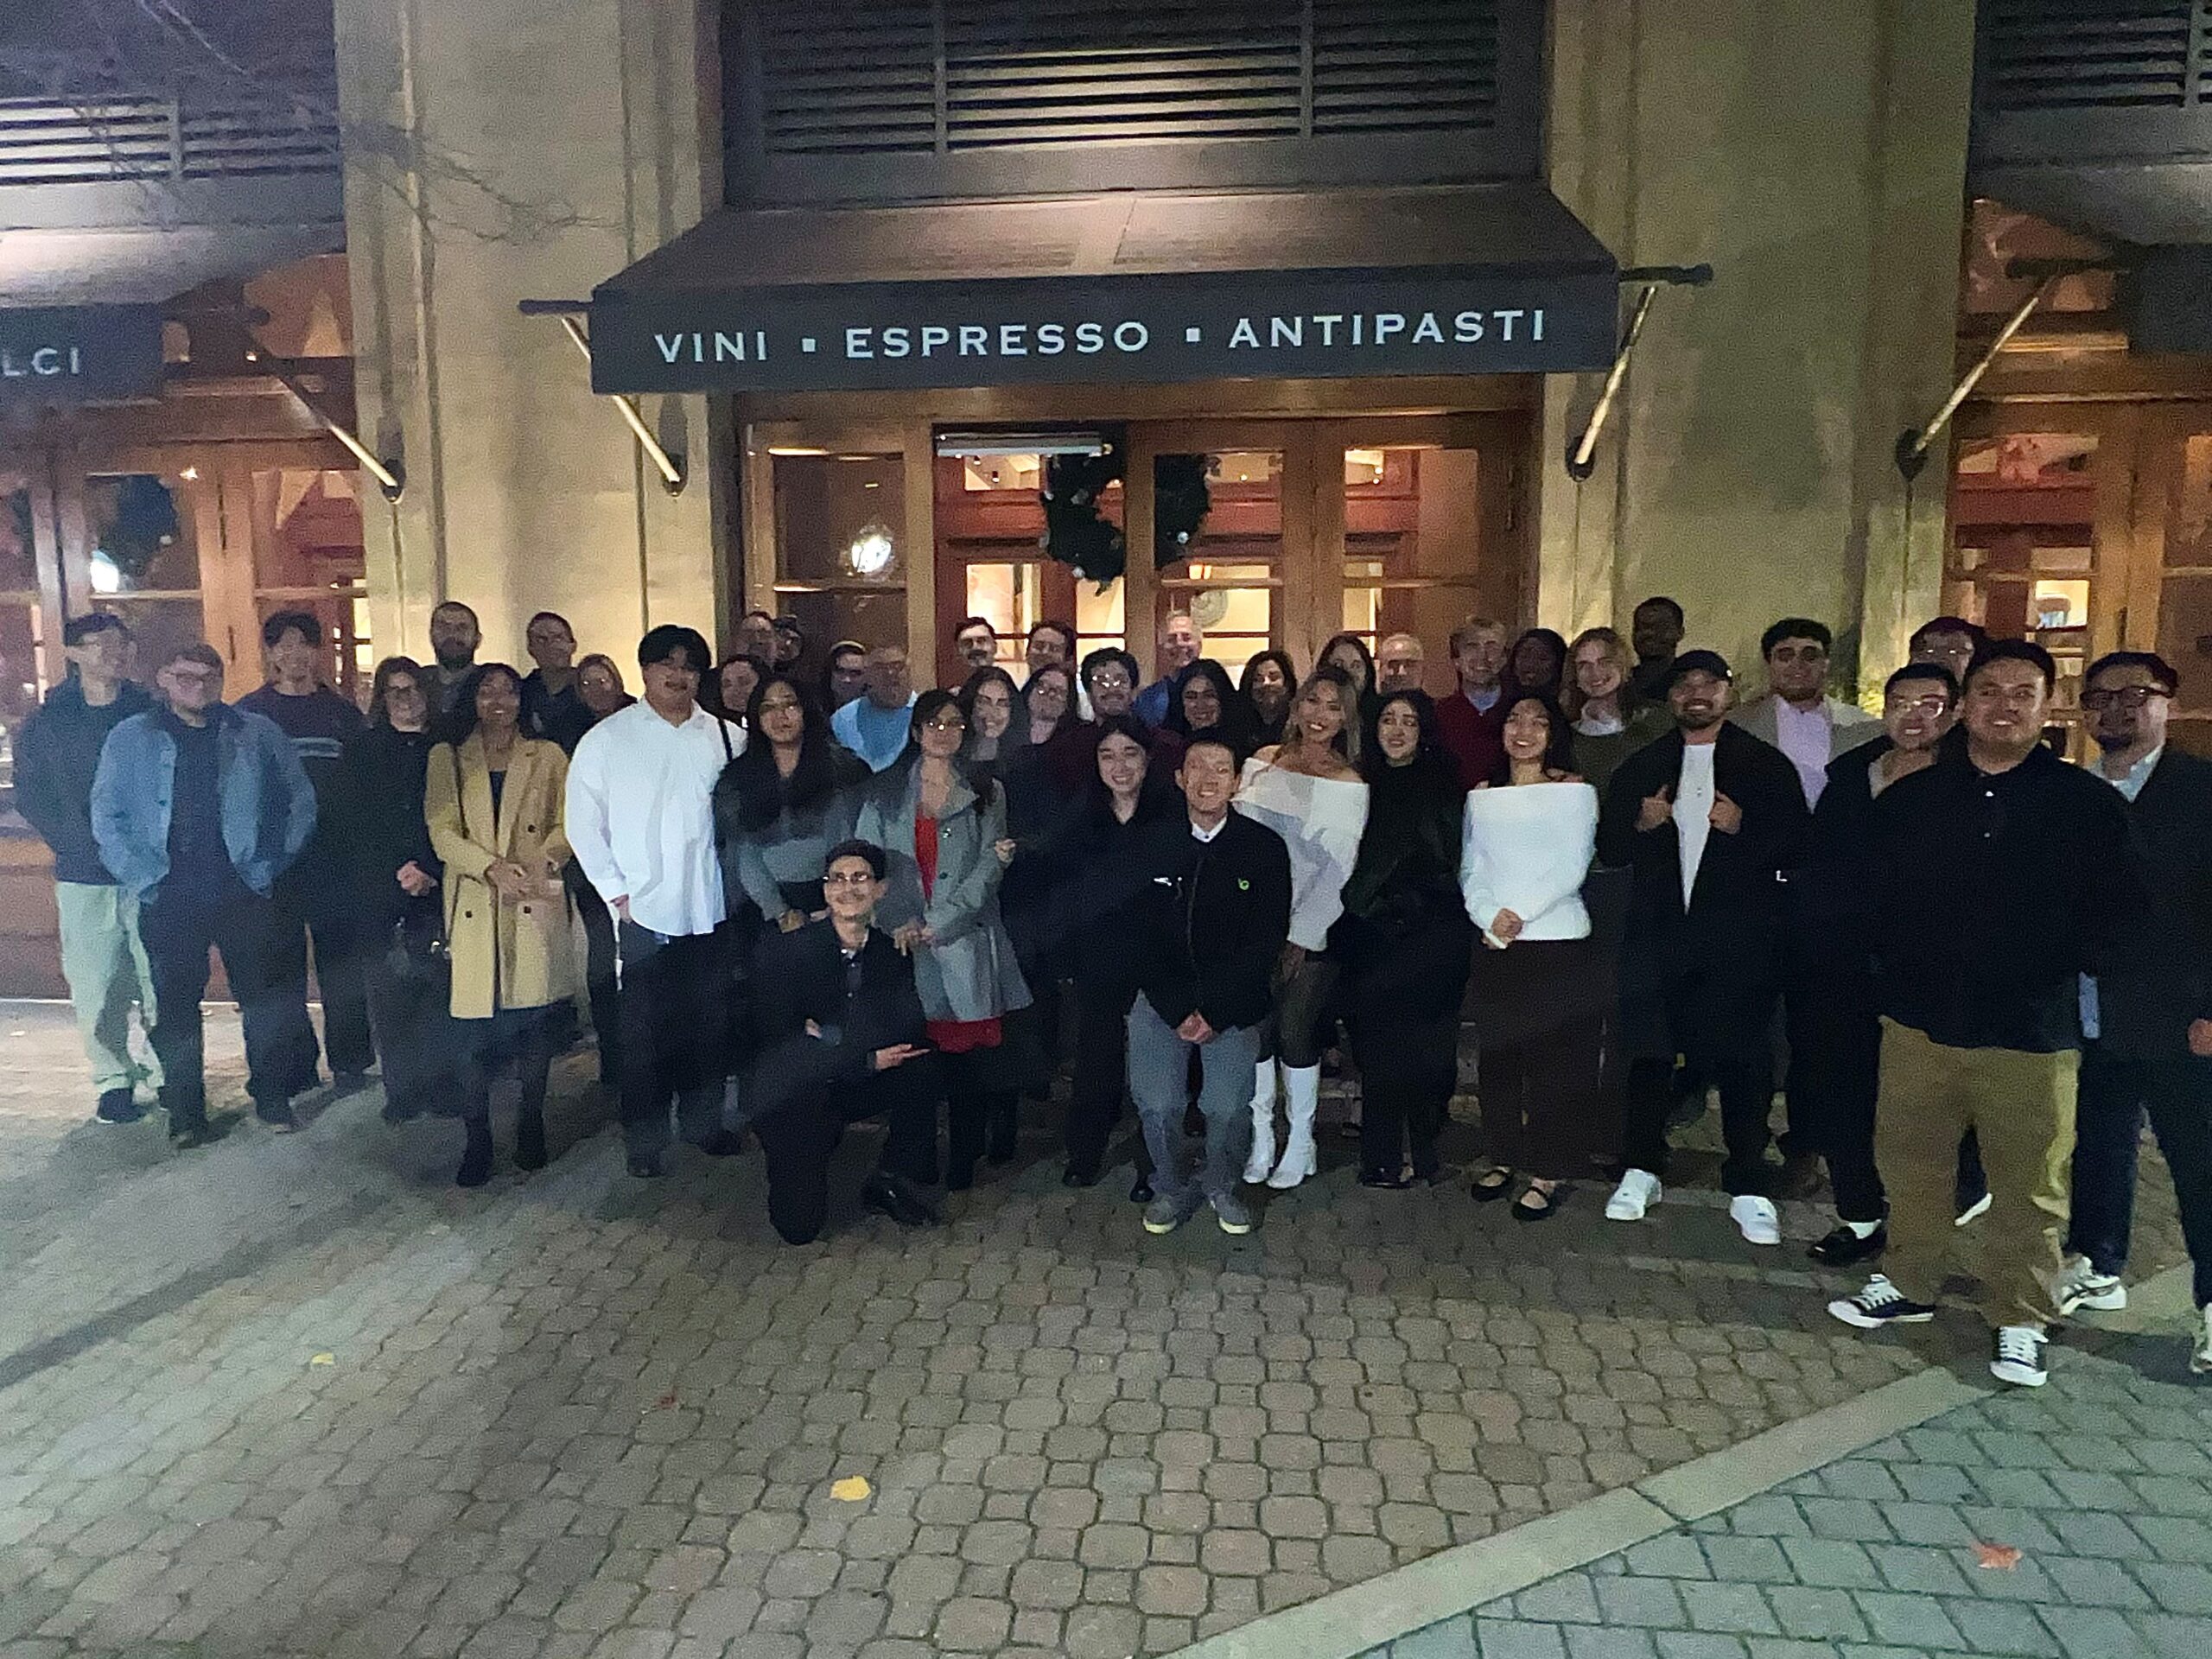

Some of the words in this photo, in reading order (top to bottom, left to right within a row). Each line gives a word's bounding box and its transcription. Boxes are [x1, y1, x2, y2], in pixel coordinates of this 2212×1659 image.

[654, 331, 766, 363] VINI
[846, 321, 1148, 359] ESPRESSO
[1228, 309, 1543, 348] ANTIPASTI
